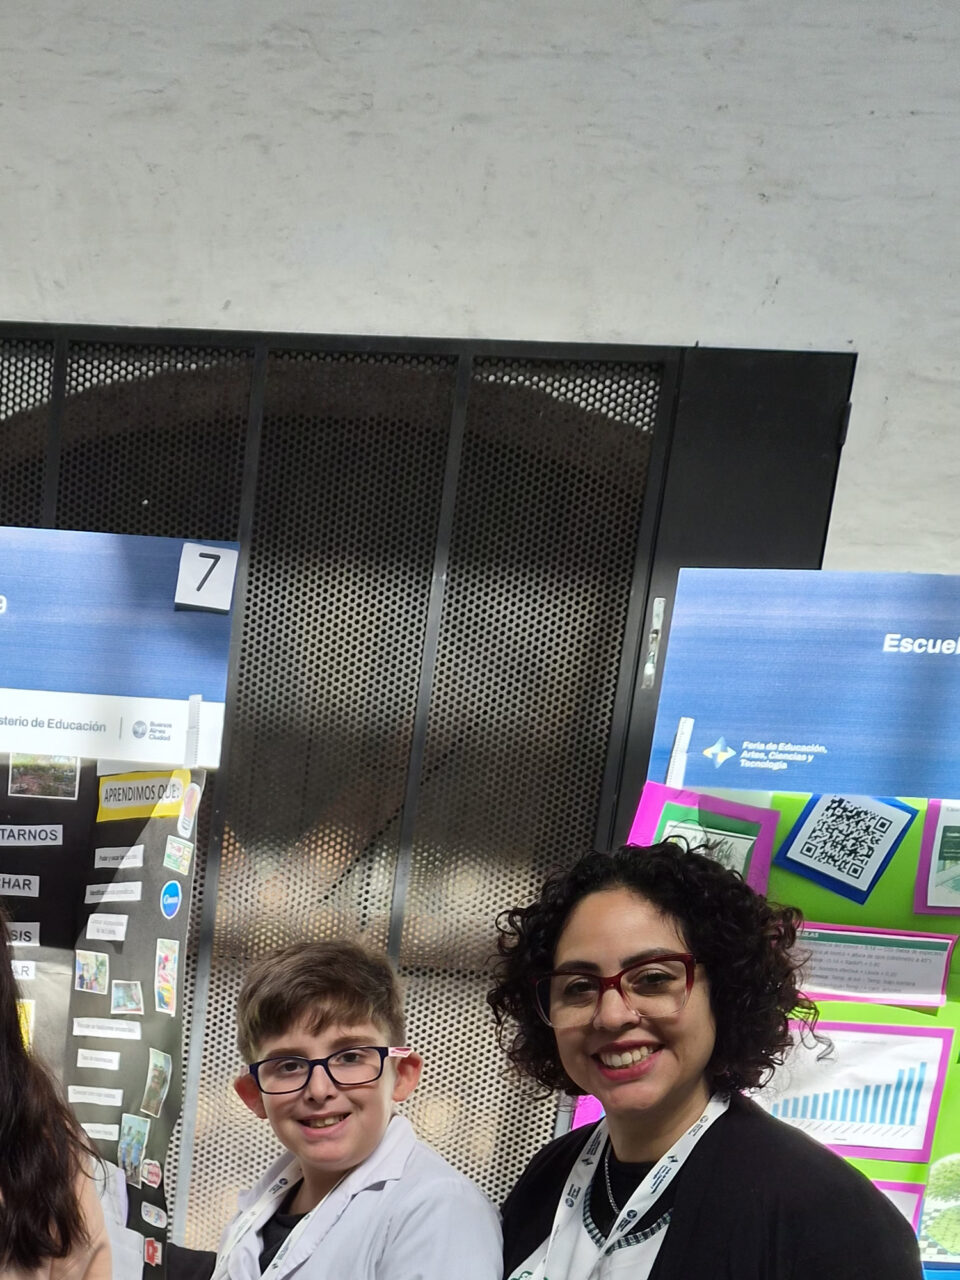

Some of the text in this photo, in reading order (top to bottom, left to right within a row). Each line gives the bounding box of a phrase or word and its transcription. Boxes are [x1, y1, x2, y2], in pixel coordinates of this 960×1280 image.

[198, 552, 221, 592] 7
[31, 717, 45, 728] de
[47, 718, 106, 732] Educación
[104, 784, 156, 803] APRENDIMOS
